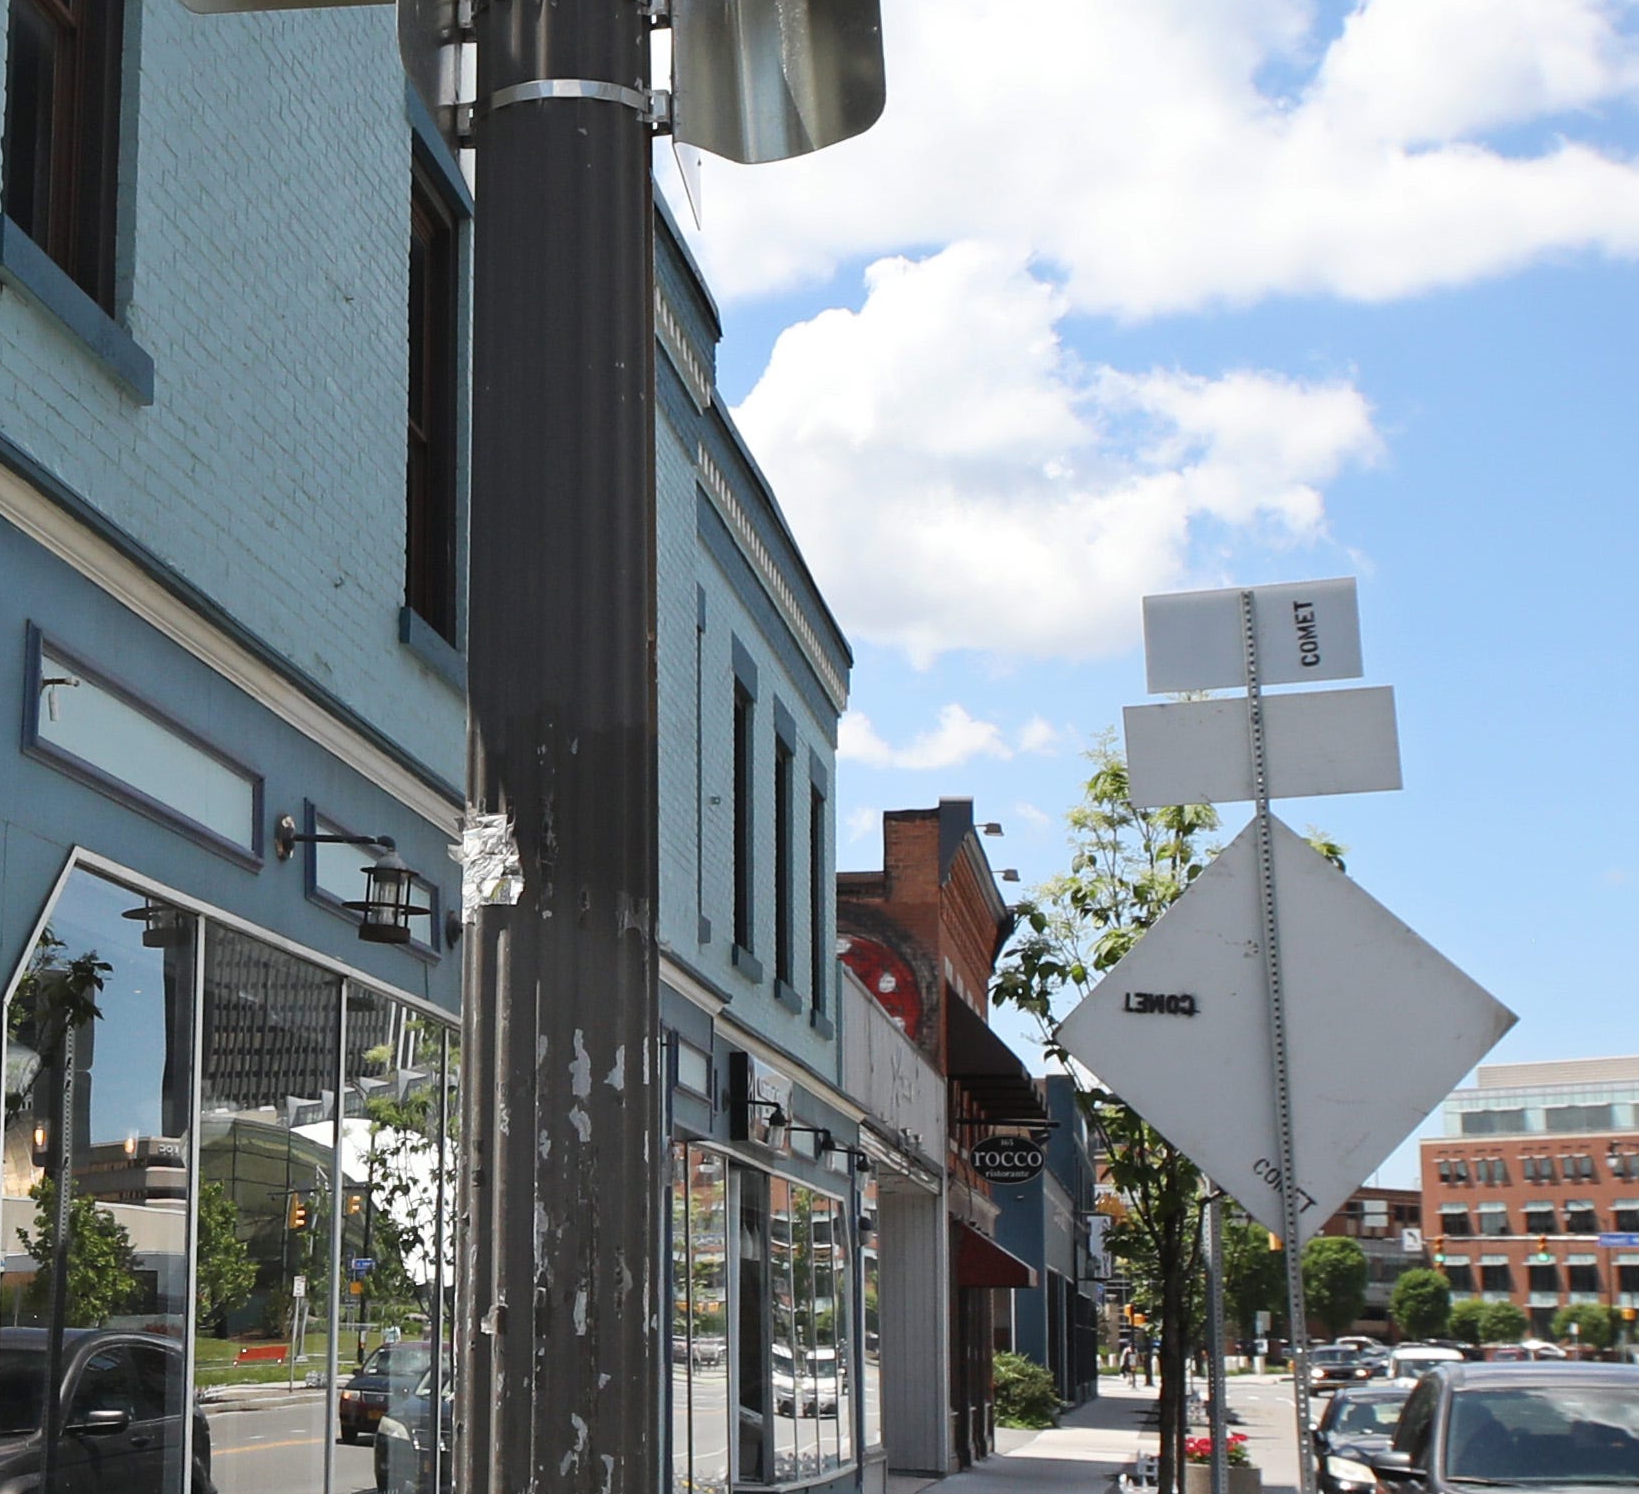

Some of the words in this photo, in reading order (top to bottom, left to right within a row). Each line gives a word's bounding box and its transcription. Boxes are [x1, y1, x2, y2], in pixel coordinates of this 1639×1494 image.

[1293, 600, 1320, 667] COMET
[974, 1150, 1043, 1168] rocco
[1253, 1158, 1317, 1214] COT
